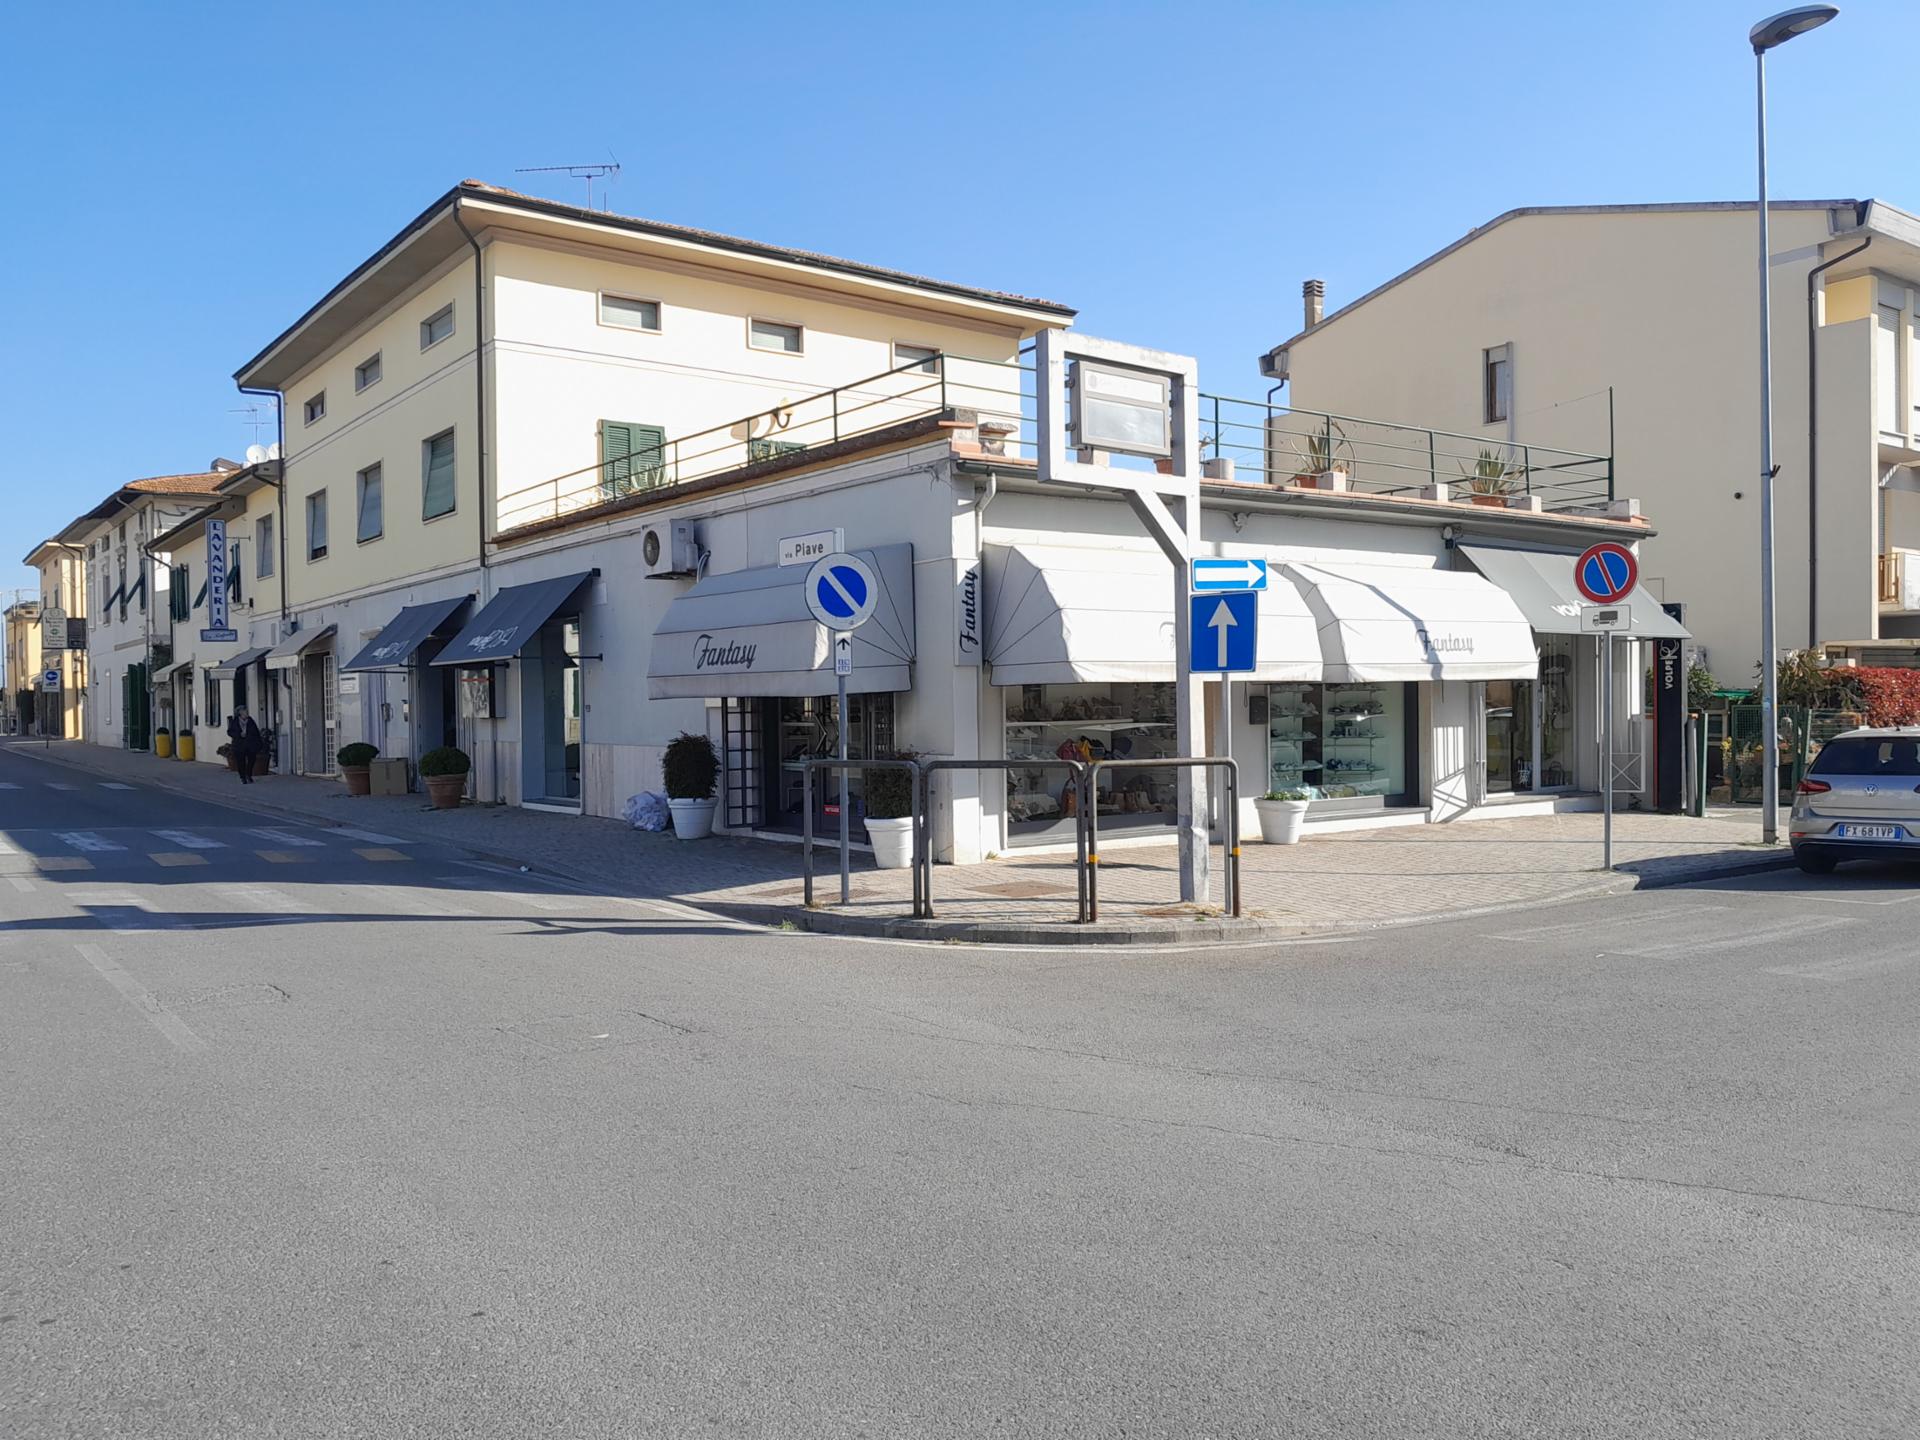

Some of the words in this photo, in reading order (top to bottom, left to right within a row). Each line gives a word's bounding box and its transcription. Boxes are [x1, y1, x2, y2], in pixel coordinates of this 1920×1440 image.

[795, 543, 824, 557] Piave
[212, 522, 224, 625] LAVANDERIA
[960, 569, 979, 654] Fantasy
[693, 633, 758, 671] Fantasy
[1415, 628, 1474, 662] Fantasy
[1664, 658, 1674, 689] VOLPE
